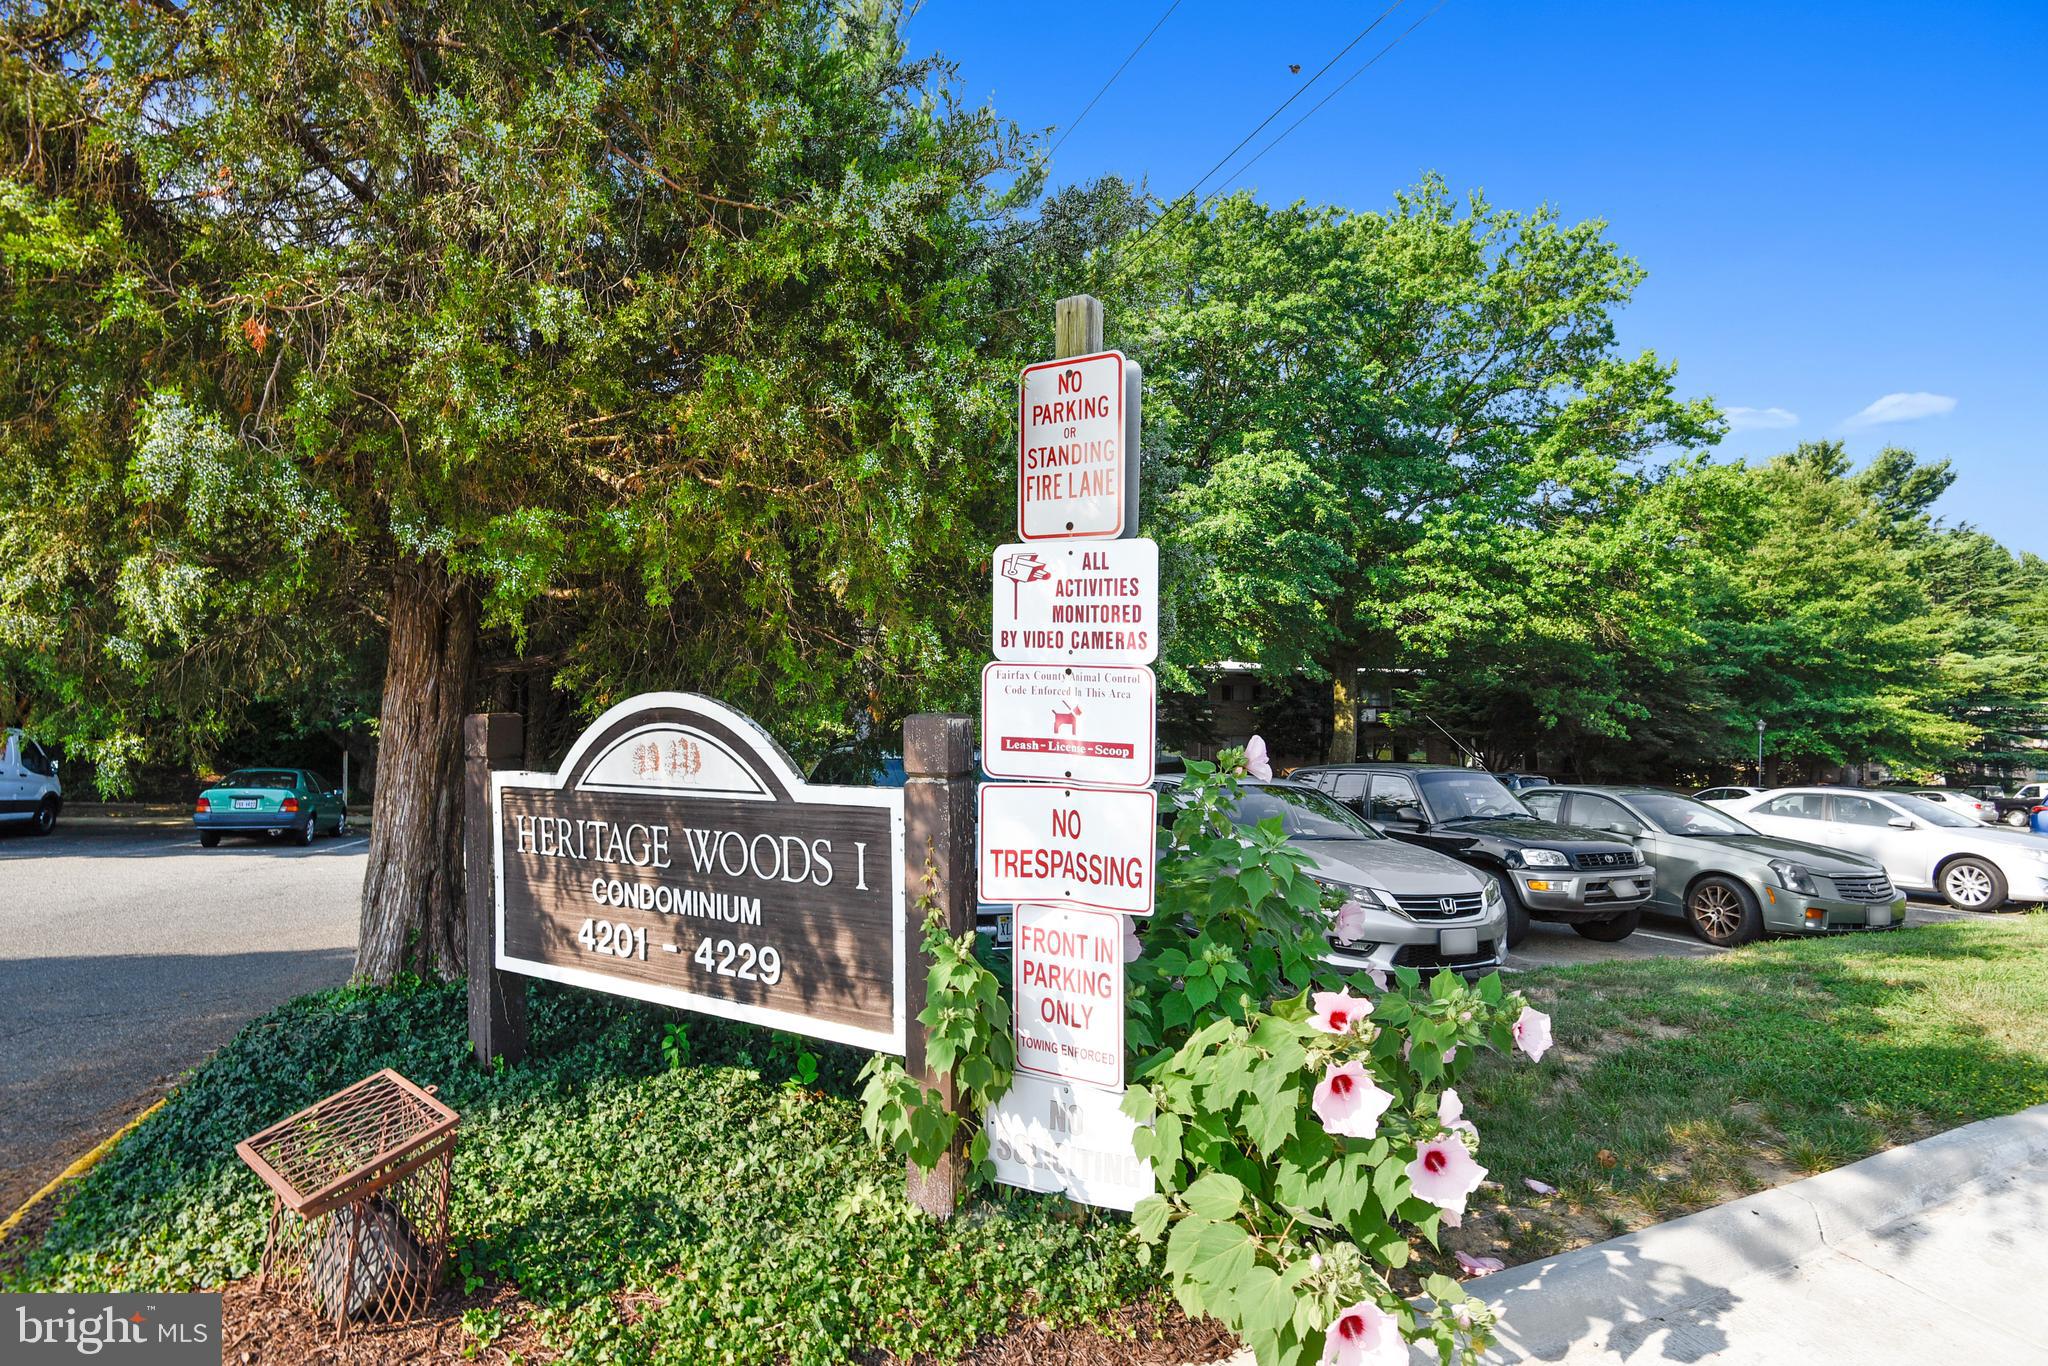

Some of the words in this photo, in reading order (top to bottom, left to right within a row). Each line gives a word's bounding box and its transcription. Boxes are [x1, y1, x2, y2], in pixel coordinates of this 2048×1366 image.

[1058, 370, 1082, 395] NO
[1032, 395, 1109, 426] PARKING
[1063, 426, 1076, 439] OR
[1027, 440, 1114, 469] STANDING
[1026, 473, 1062, 502] FIRE
[1068, 469, 1115, 498] LANE
[1082, 552, 1109, 570] ALL
[1055, 577, 1139, 597] ACTIVITIES
[1052, 604, 1142, 623] MONITORED
[1001, 631, 1017, 648] BY
[1023, 631, 1064, 649] VIDEO
[1071, 631, 1148, 650] CAMERAS
[996, 670, 1030, 680] Fairfax
[1033, 670, 1066, 683] County
[1104, 672, 1140, 684] Control
[1004, 685, 1027, 695] Code
[1031, 685, 1071, 696] Enforced
[1074, 686, 1082, 697] In
[1086, 688, 1106, 698] This
[1109, 688, 1131, 699] Area
[1006, 739, 1039, 750] Leash
[1095, 745, 1130, 758] Scoop
[1052, 808, 1081, 840] NO
[516, 814, 672, 869] HERITAGE
[682, 827, 834, 887] WOODS
[854, 842, 869, 891] I
[990, 848, 1143, 889] TRESPASSING
[592, 877, 762, 926] CONDOMINIUM
[577, 918, 648, 961] 4201
[694, 937, 782, 986] 4229
[1021, 925, 1088, 959] FRONT
[1095, 936, 1113, 964] IN
[1023, 960, 1112, 998] PARKING
[1041, 997, 1093, 1030] ONLY
[1020, 1035, 1058, 1054] TOWING
[1061, 1044, 1115, 1065] ENFORCED
